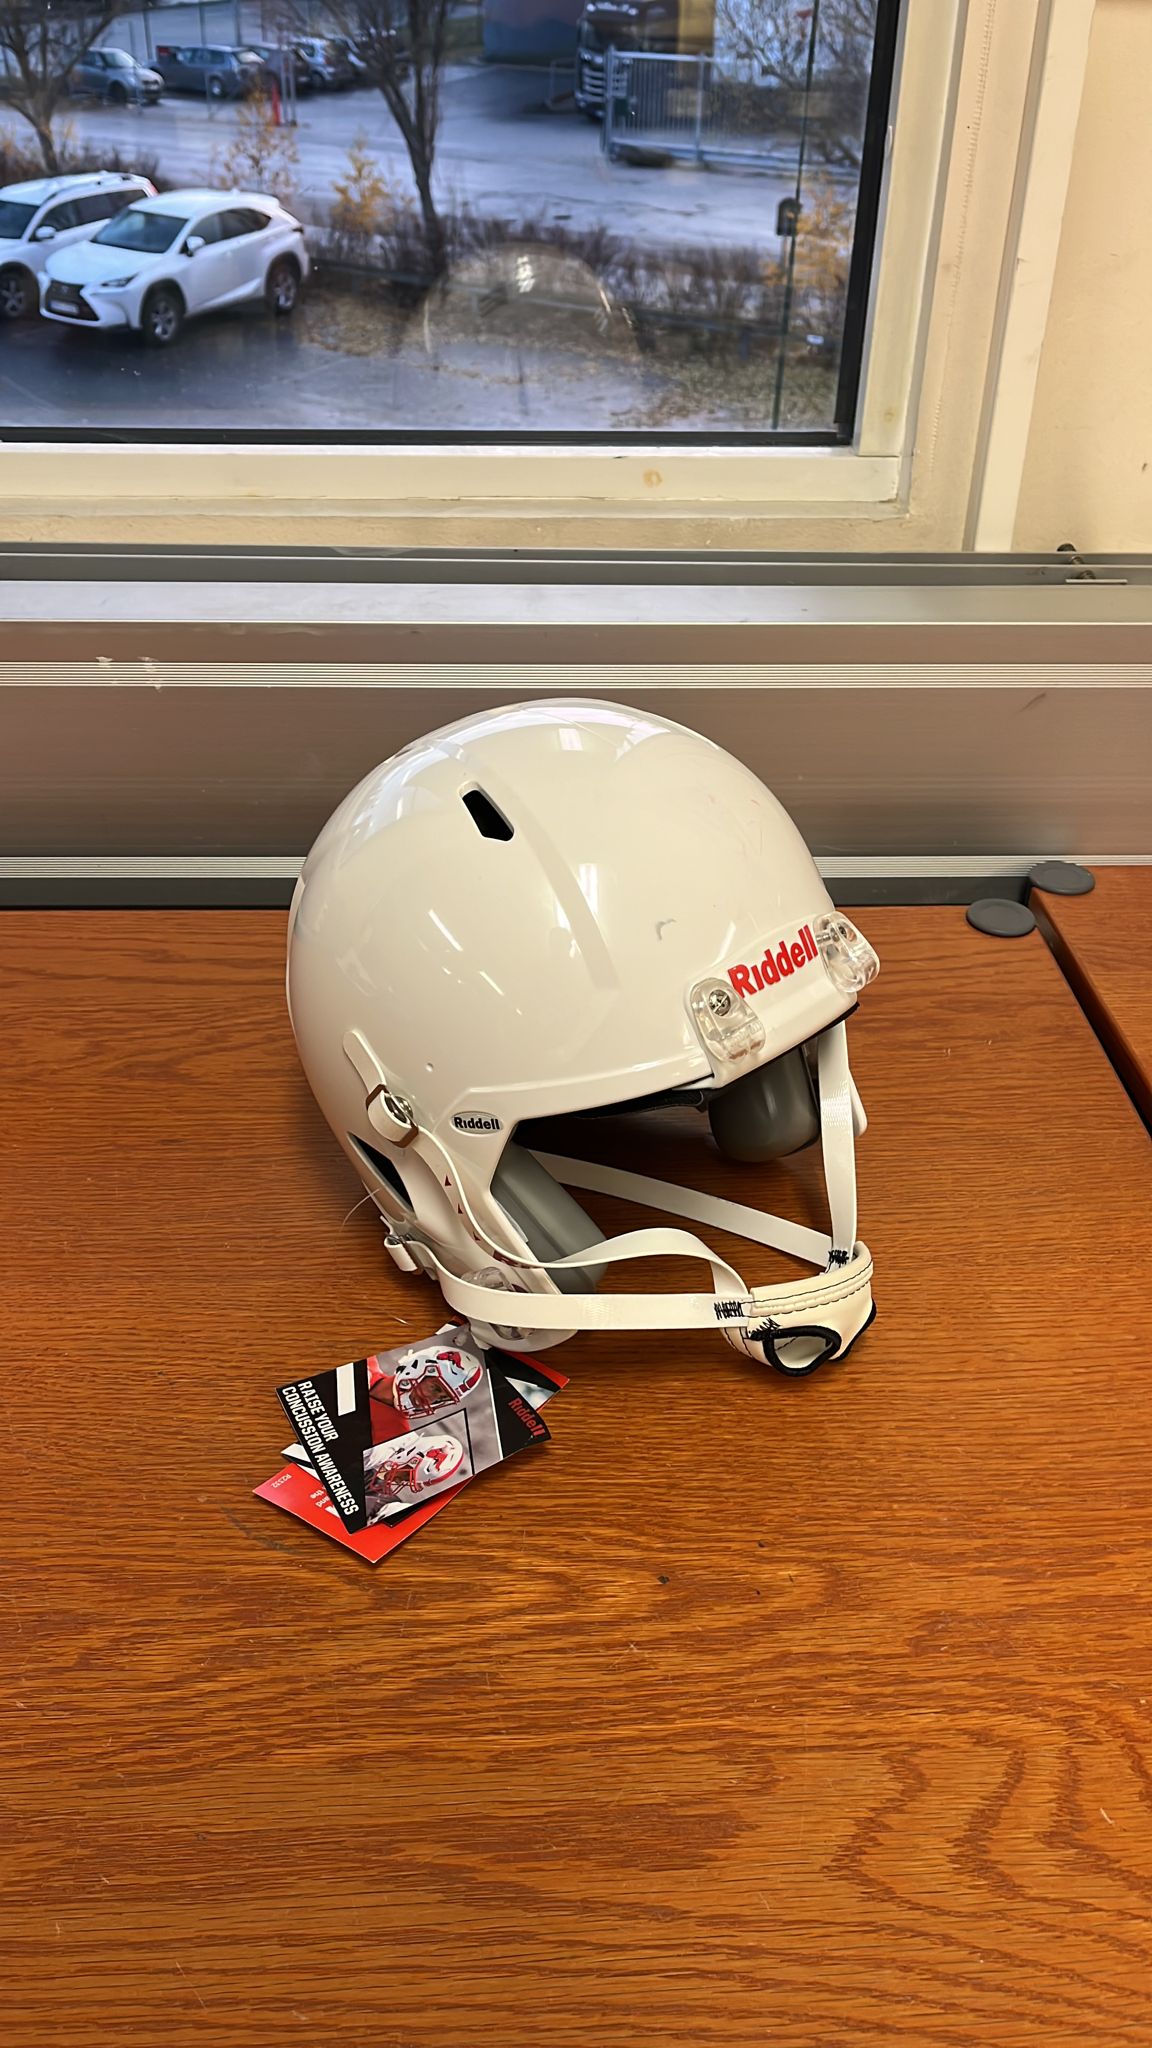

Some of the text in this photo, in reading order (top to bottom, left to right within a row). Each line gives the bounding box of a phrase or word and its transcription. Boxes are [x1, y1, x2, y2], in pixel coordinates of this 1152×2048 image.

[727, 924, 819, 998] Riddell
[453, 1116, 500, 1130] Riddell
[298, 1380, 339, 1442] RAISE YOUR
[508, 1397, 545, 1436] Riddell
[282, 1386, 359, 1516] CONCUSSION AWARENESS
